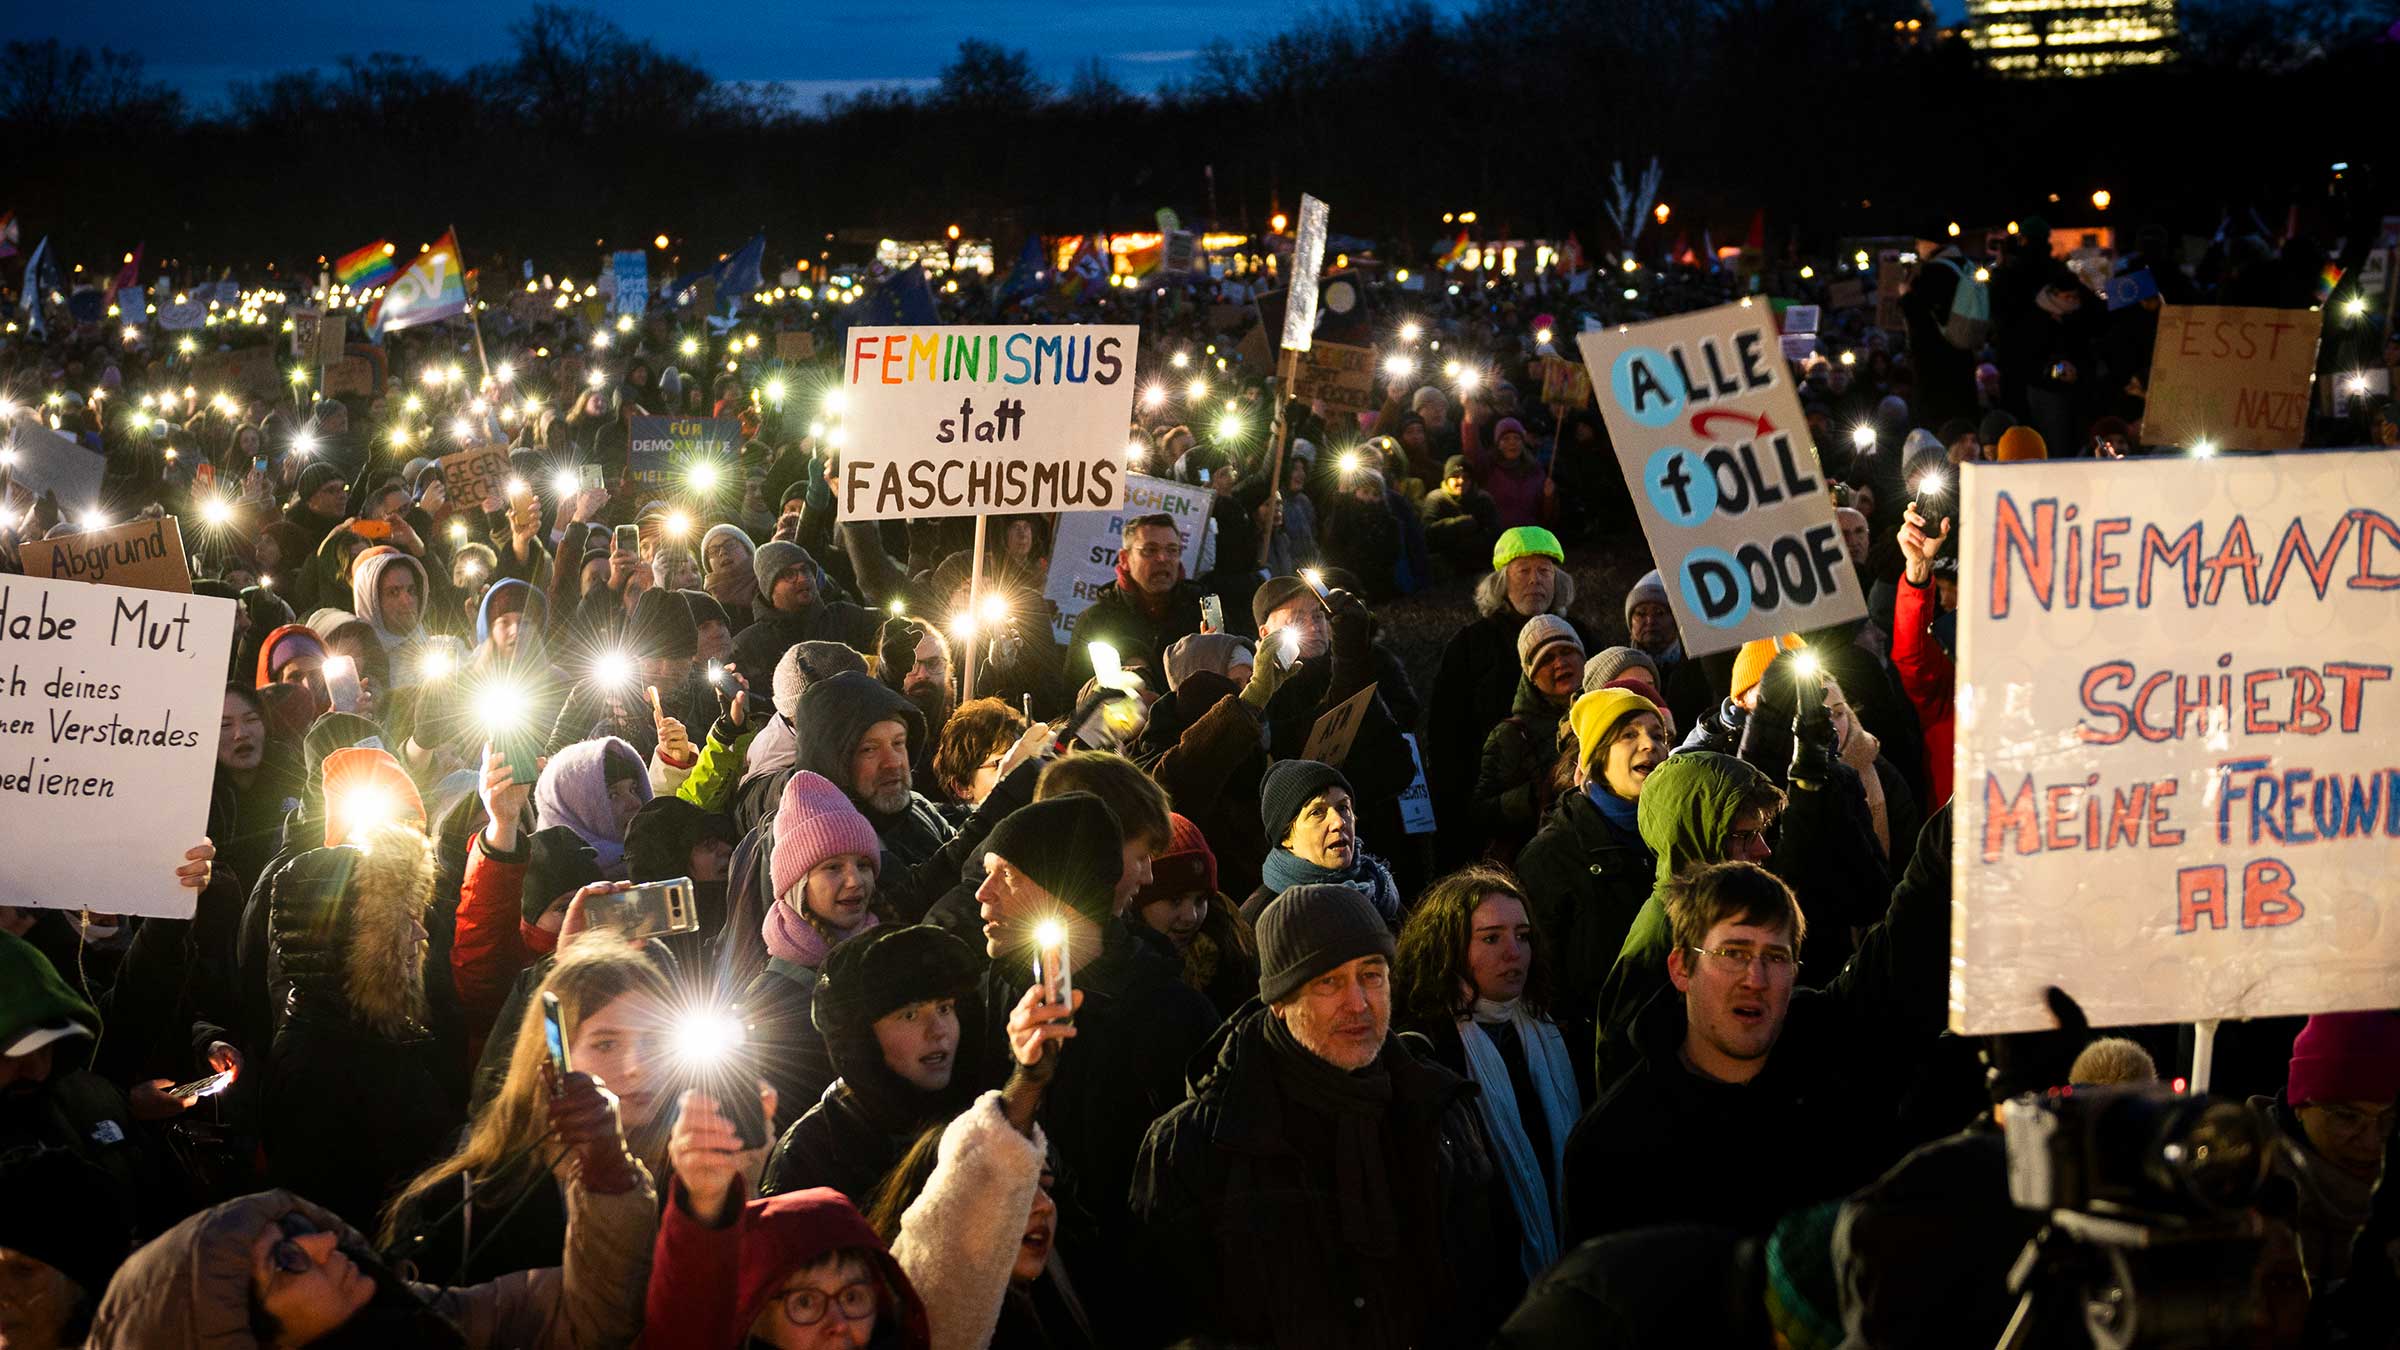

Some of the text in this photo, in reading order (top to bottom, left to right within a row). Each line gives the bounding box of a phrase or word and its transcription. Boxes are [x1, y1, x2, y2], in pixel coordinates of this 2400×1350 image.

[852, 333, 1122, 385] FEMINISMUS
[2180, 321, 2295, 361] ESST
[1628, 328, 1775, 414] ALLE
[669, 420, 703, 437] FÜR
[936, 398, 1026, 443] statt
[2233, 387, 2306, 432] NAZIS
[444, 452, 511, 484] GEGEN
[846, 459, 1117, 514] FASCHISMUS
[51, 523, 167, 582] Abgrund
[1688, 524, 1844, 621] DOOF
[111, 596, 196, 659] Mut,
[45, 666, 121, 700] deines
[49, 708, 200, 748] Verstandes
[2176, 858, 2305, 936] AB
